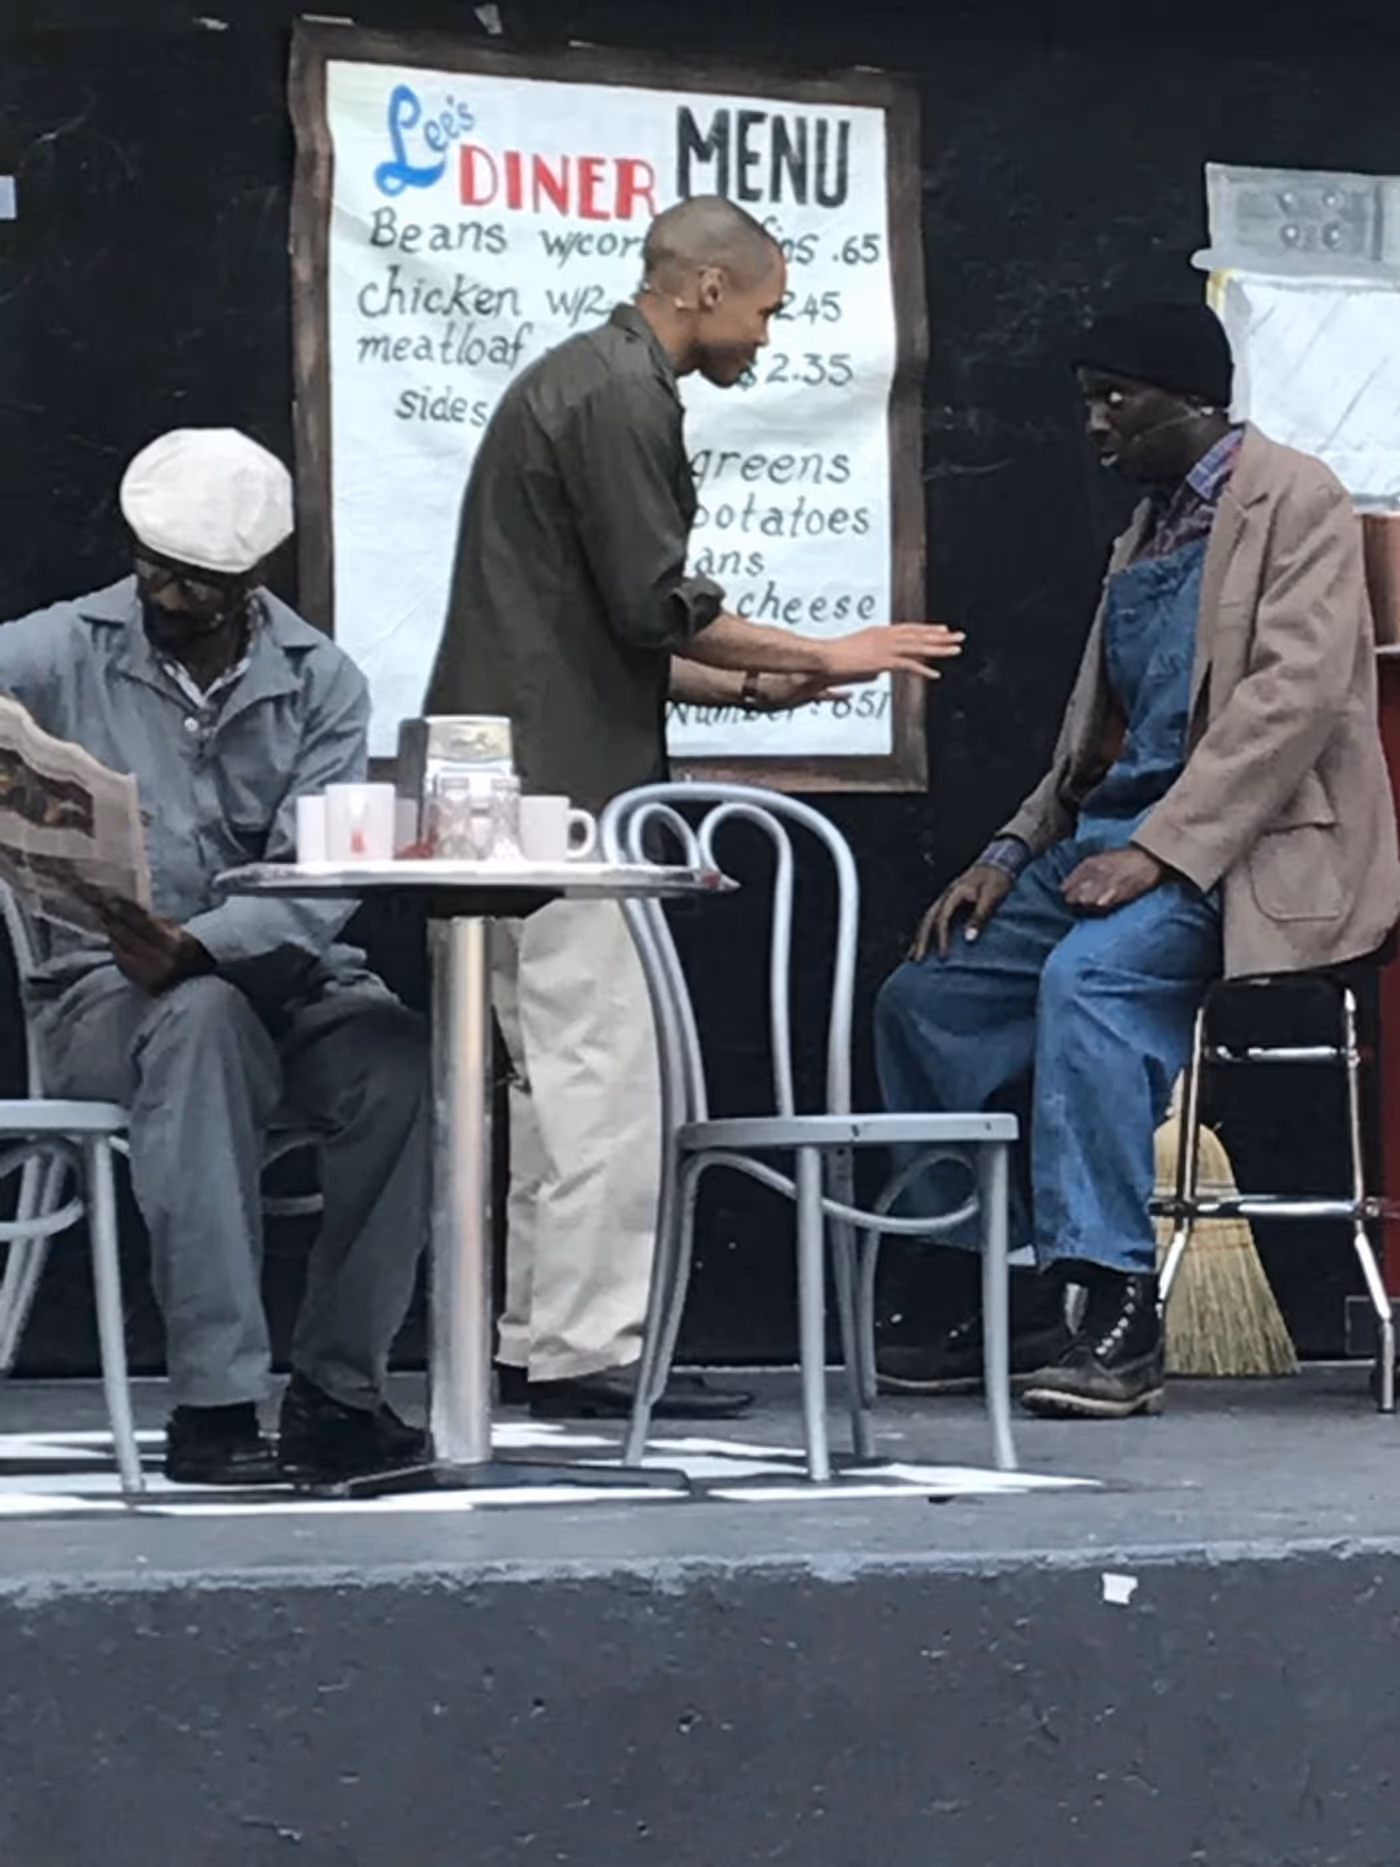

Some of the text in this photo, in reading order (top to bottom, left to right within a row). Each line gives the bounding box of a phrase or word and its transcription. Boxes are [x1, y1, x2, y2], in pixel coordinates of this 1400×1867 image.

[374, 84, 475, 197] Lee's
[677, 105, 851, 209] MENU
[459, 144, 657, 221] DINER
[370, 206, 508, 254] Beans
[539, 229, 644, 269] w/cor
[832, 233, 881, 265] .65
[357, 264, 522, 318] chicken
[357, 321, 534, 370] meatloaf
[394, 385, 489, 427] sides
[690, 449, 851, 492] greens
[693, 547, 766, 577] ans
[736, 580, 876, 625] cheese
